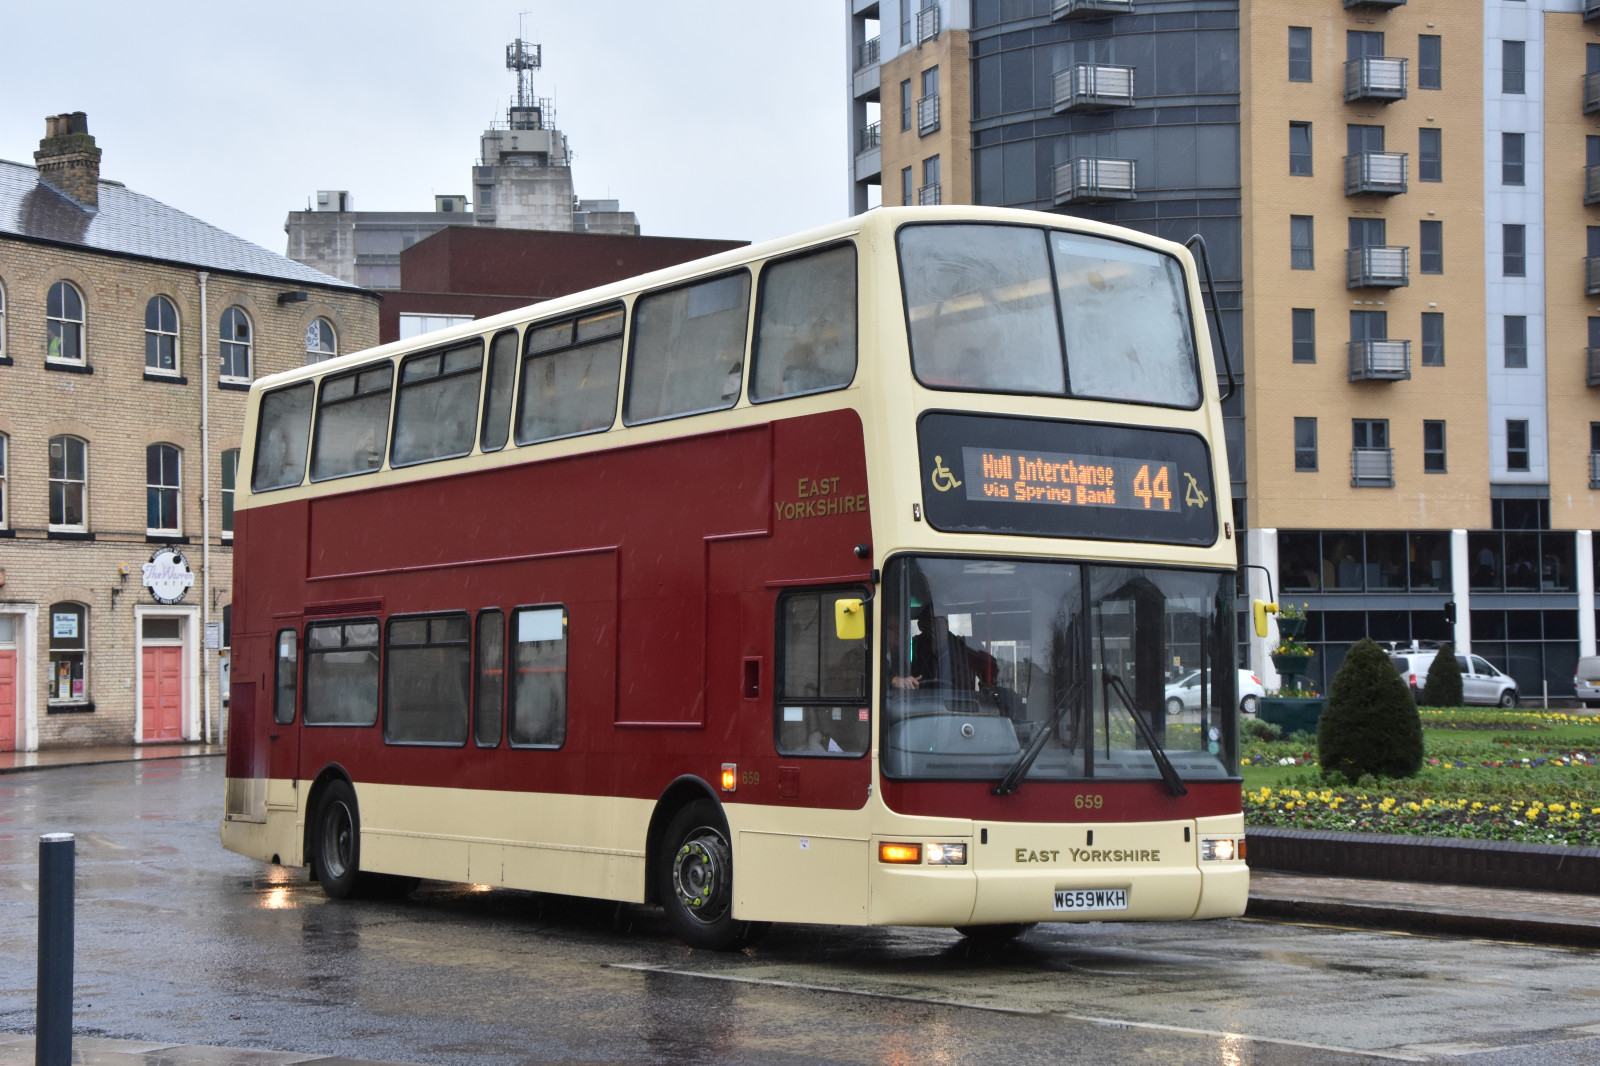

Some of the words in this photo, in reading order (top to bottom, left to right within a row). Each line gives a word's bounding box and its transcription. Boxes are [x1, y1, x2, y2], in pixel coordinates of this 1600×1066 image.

[982, 454, 1012, 479] Hull
[1018, 456, 1114, 486] Interchange
[798, 477, 840, 498] EAST
[983, 482, 1009, 497] via
[1014, 481, 1071, 503] Spring
[1076, 485, 1115, 504] Bank
[1133, 465, 1172, 510] 44
[775, 494, 867, 520] YORKSHIRE
[742, 771, 760, 786] 659
[1074, 795, 1103, 809] 659
[1015, 847, 1060, 863] EAST
[1068, 847, 1161, 863] YORKSHIRE
[1054, 891, 1125, 908] W659WKH
